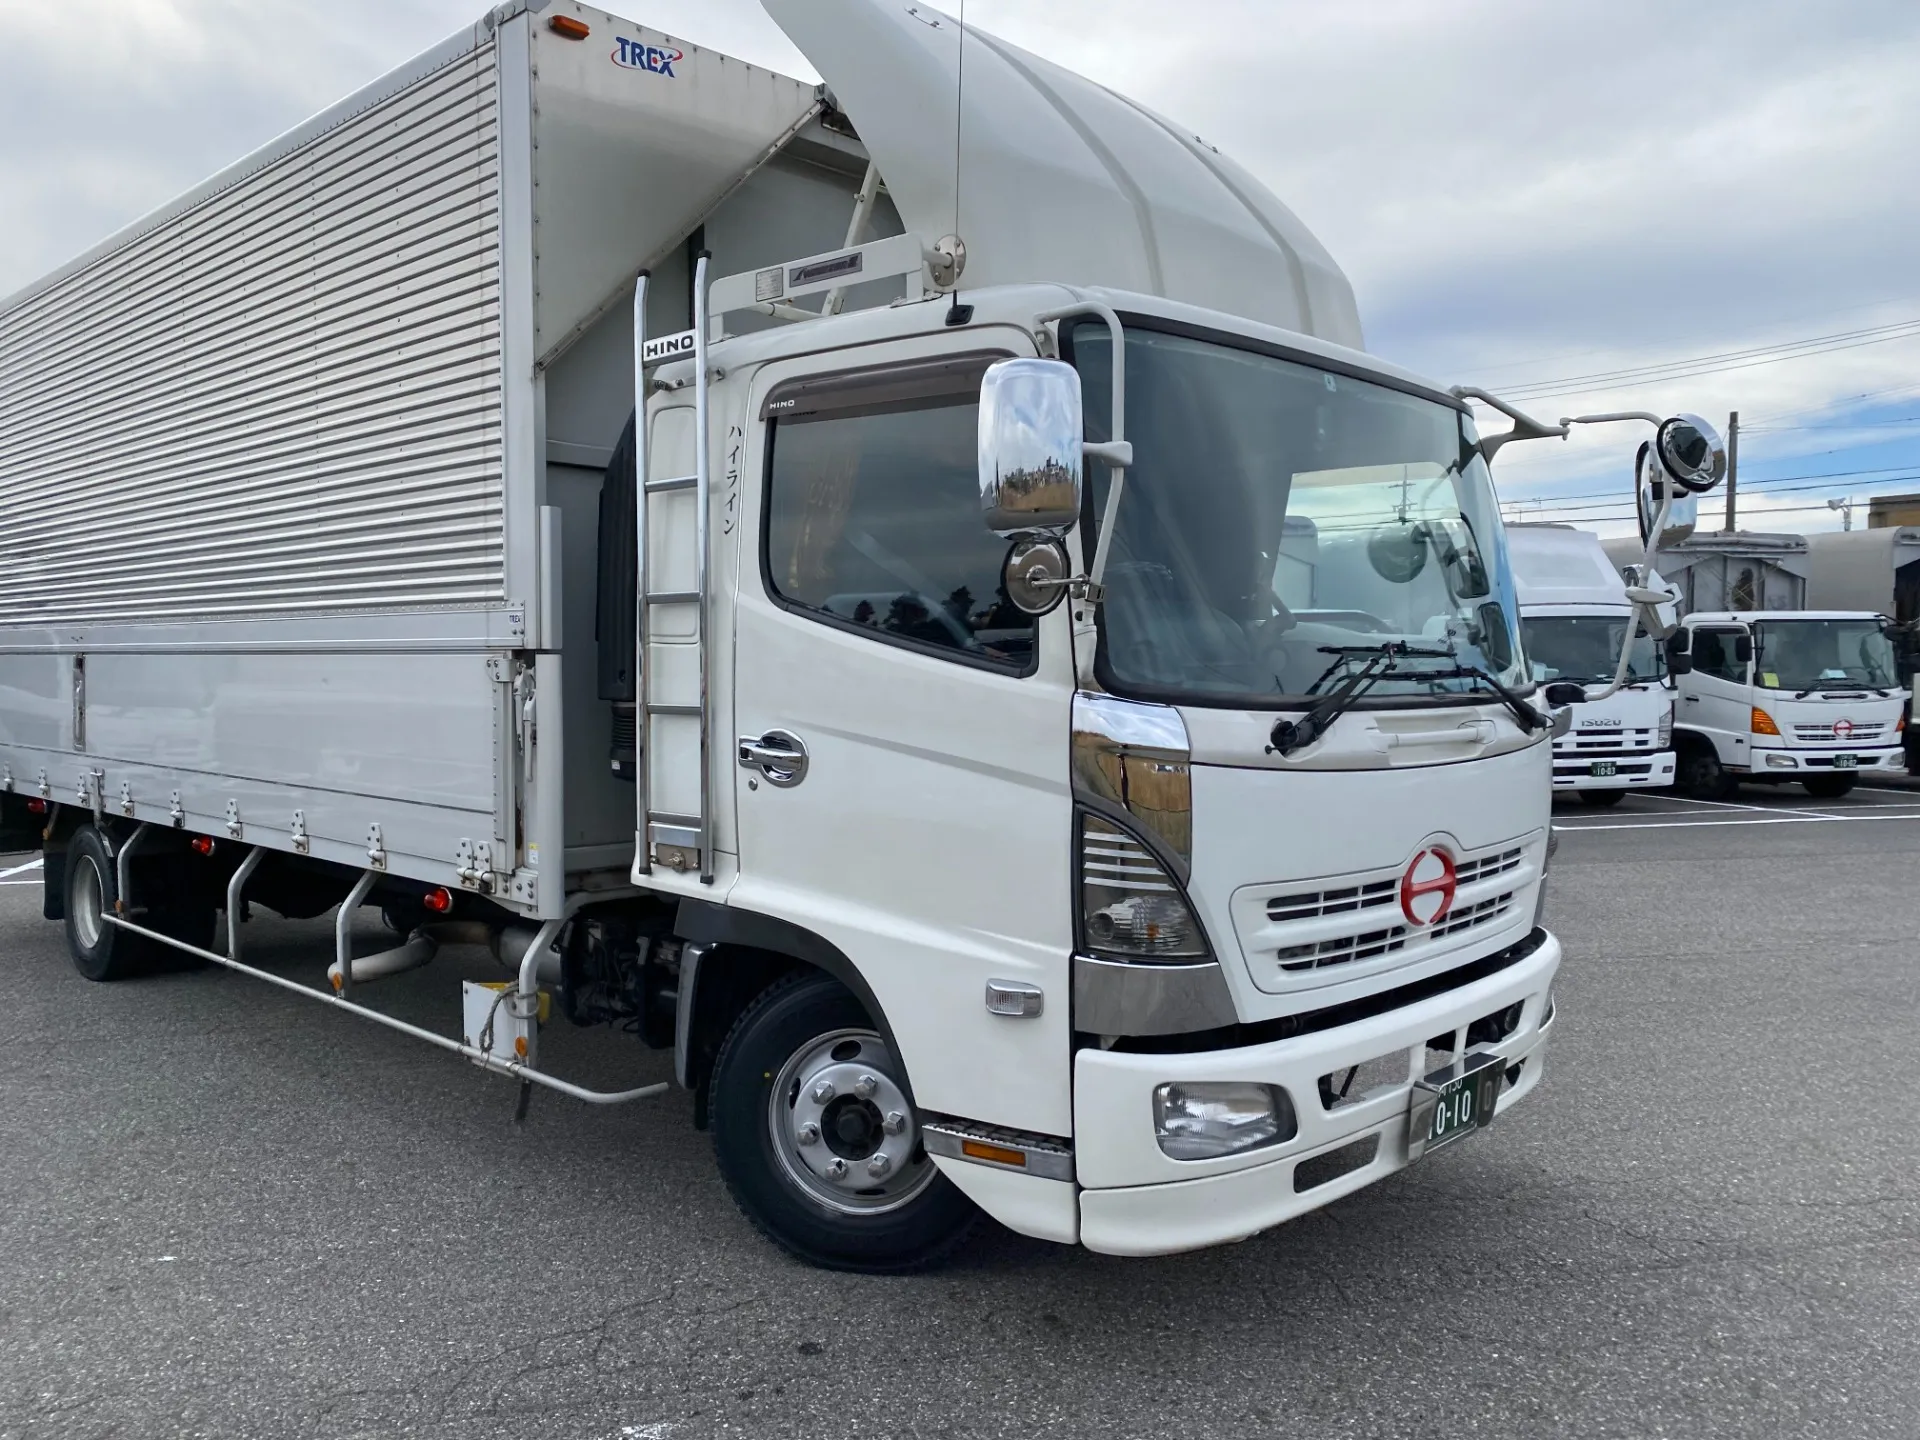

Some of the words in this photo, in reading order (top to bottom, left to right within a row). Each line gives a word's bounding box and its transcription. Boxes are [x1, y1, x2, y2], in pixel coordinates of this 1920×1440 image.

[615, 36, 676, 78] TREX
[646, 334, 694, 358] HINO
[770, 400, 795, 409] HINO
[724, 425, 742, 535] ハイライン
[1581, 717, 1622, 727] ISUZU
